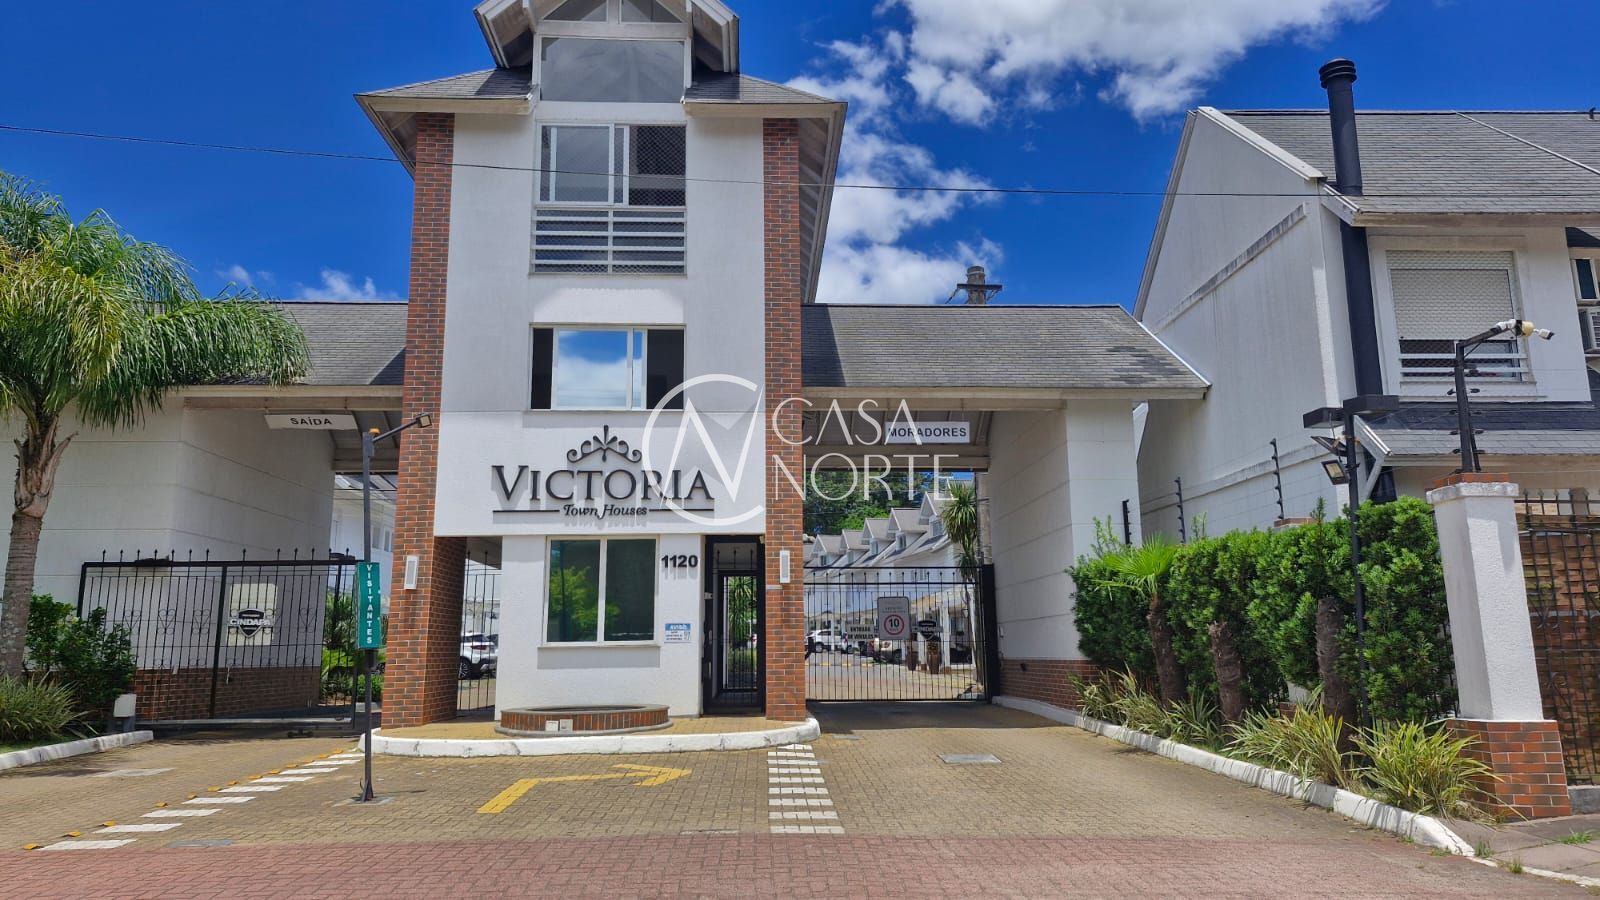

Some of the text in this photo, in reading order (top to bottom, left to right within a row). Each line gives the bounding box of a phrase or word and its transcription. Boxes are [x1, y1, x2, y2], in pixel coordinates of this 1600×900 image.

[290, 416, 333, 426] SAÍDA
[888, 427, 967, 437] MORADORES
[491, 465, 715, 501] VICTORIA
[563, 504, 648, 520] Town Houses
[661, 555, 699, 568] 1120
[366, 564, 374, 644] VISITANTES
[888, 618, 900, 628] 10
